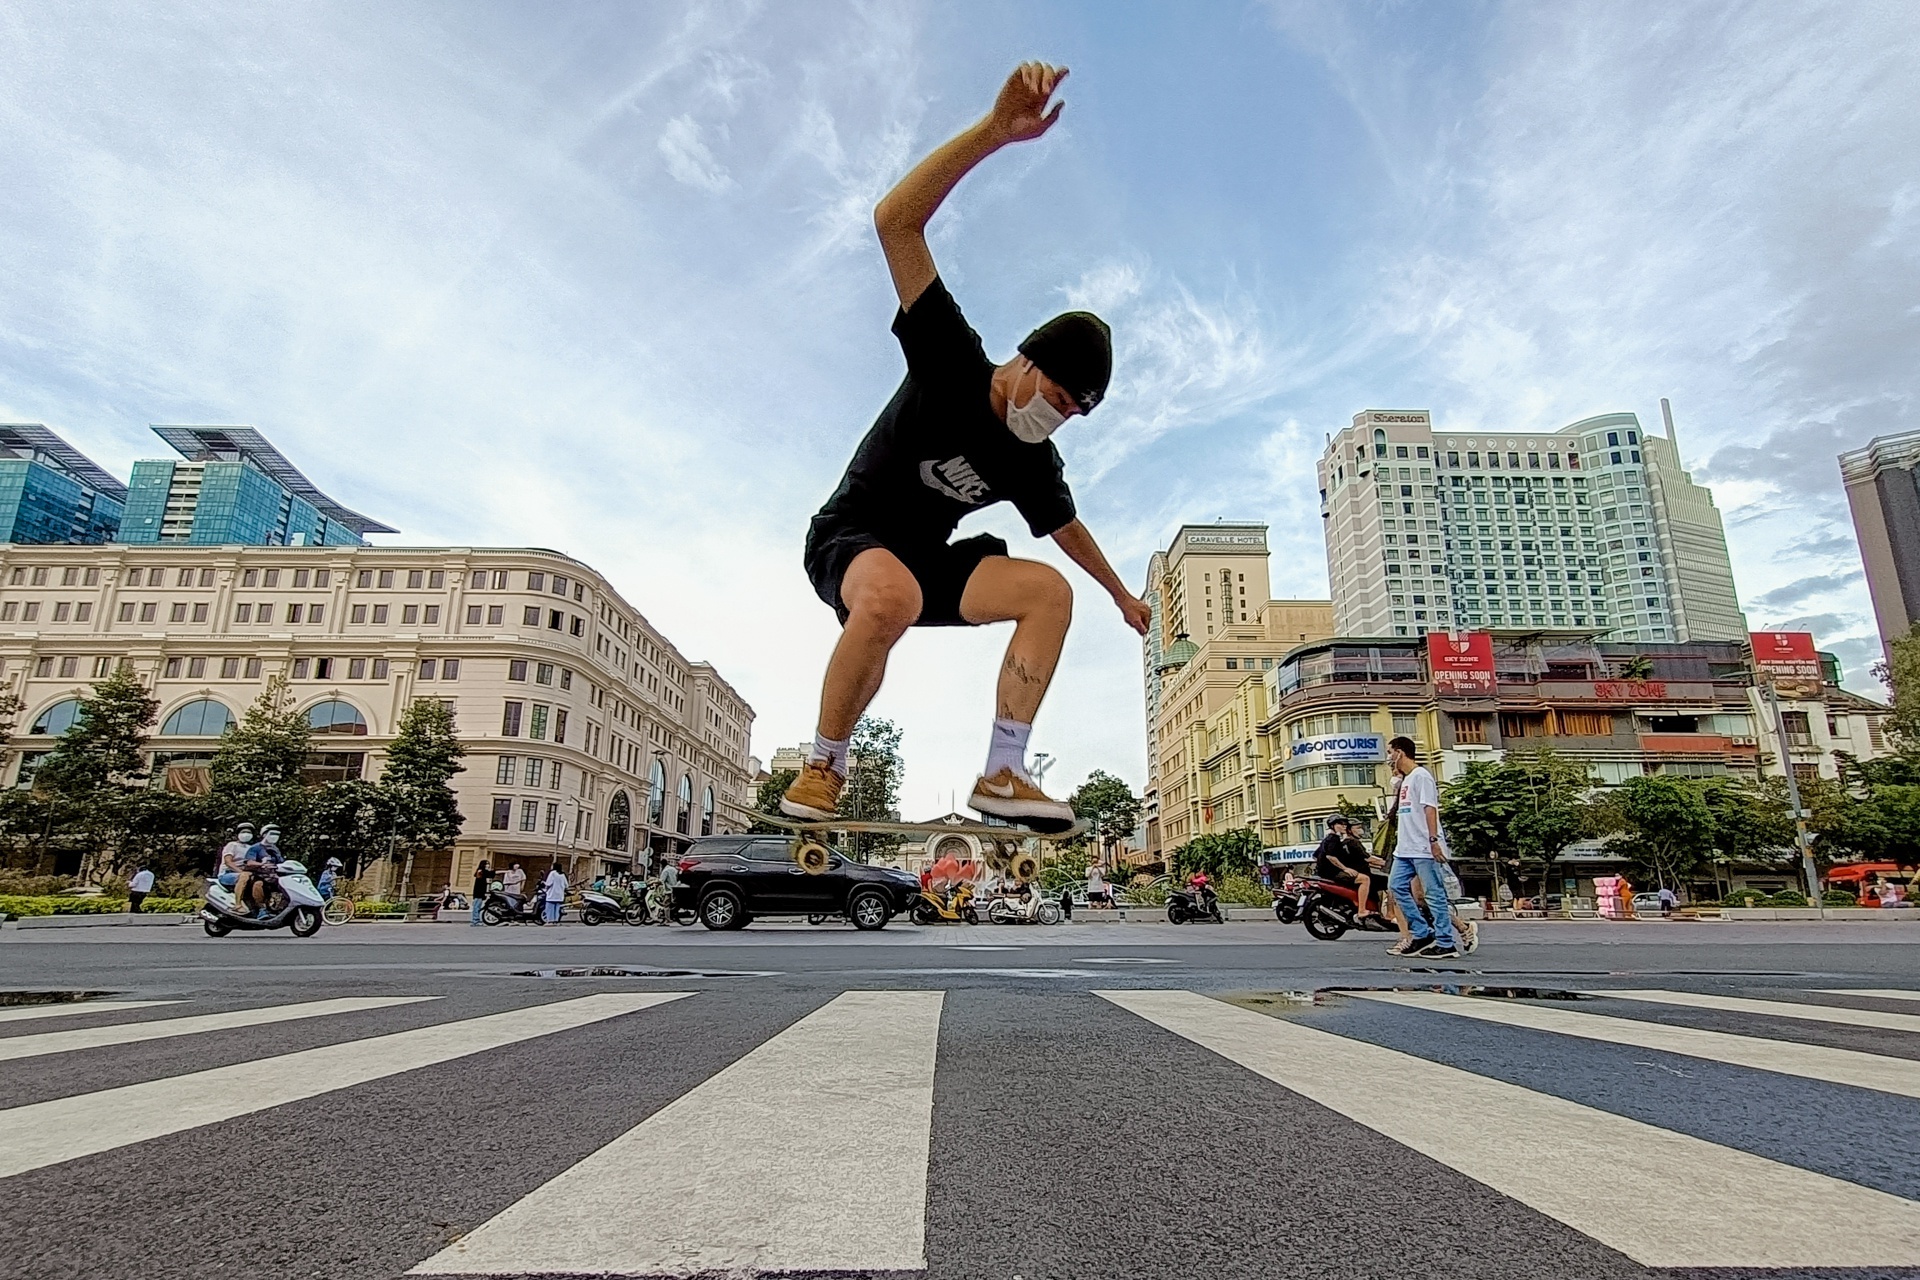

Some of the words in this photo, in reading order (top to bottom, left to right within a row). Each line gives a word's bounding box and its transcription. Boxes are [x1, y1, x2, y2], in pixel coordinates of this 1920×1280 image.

[1373, 413, 1425, 423] Sheraton
[937, 455, 991, 502] NIKE
[1190, 536, 1235, 544] CARAVELLE
[1237, 536, 1263, 544] HOTEL
[1434, 670, 1468, 680] OPENING
[1470, 670, 1490, 680] SOON
[1761, 664, 1796, 675] OPENING
[1797, 665, 1818, 675] SOON
[1594, 683, 1623, 698] SKY
[1627, 683, 1667, 698] ZONE
[1292, 738, 1379, 756] SAIGONTOURIST
